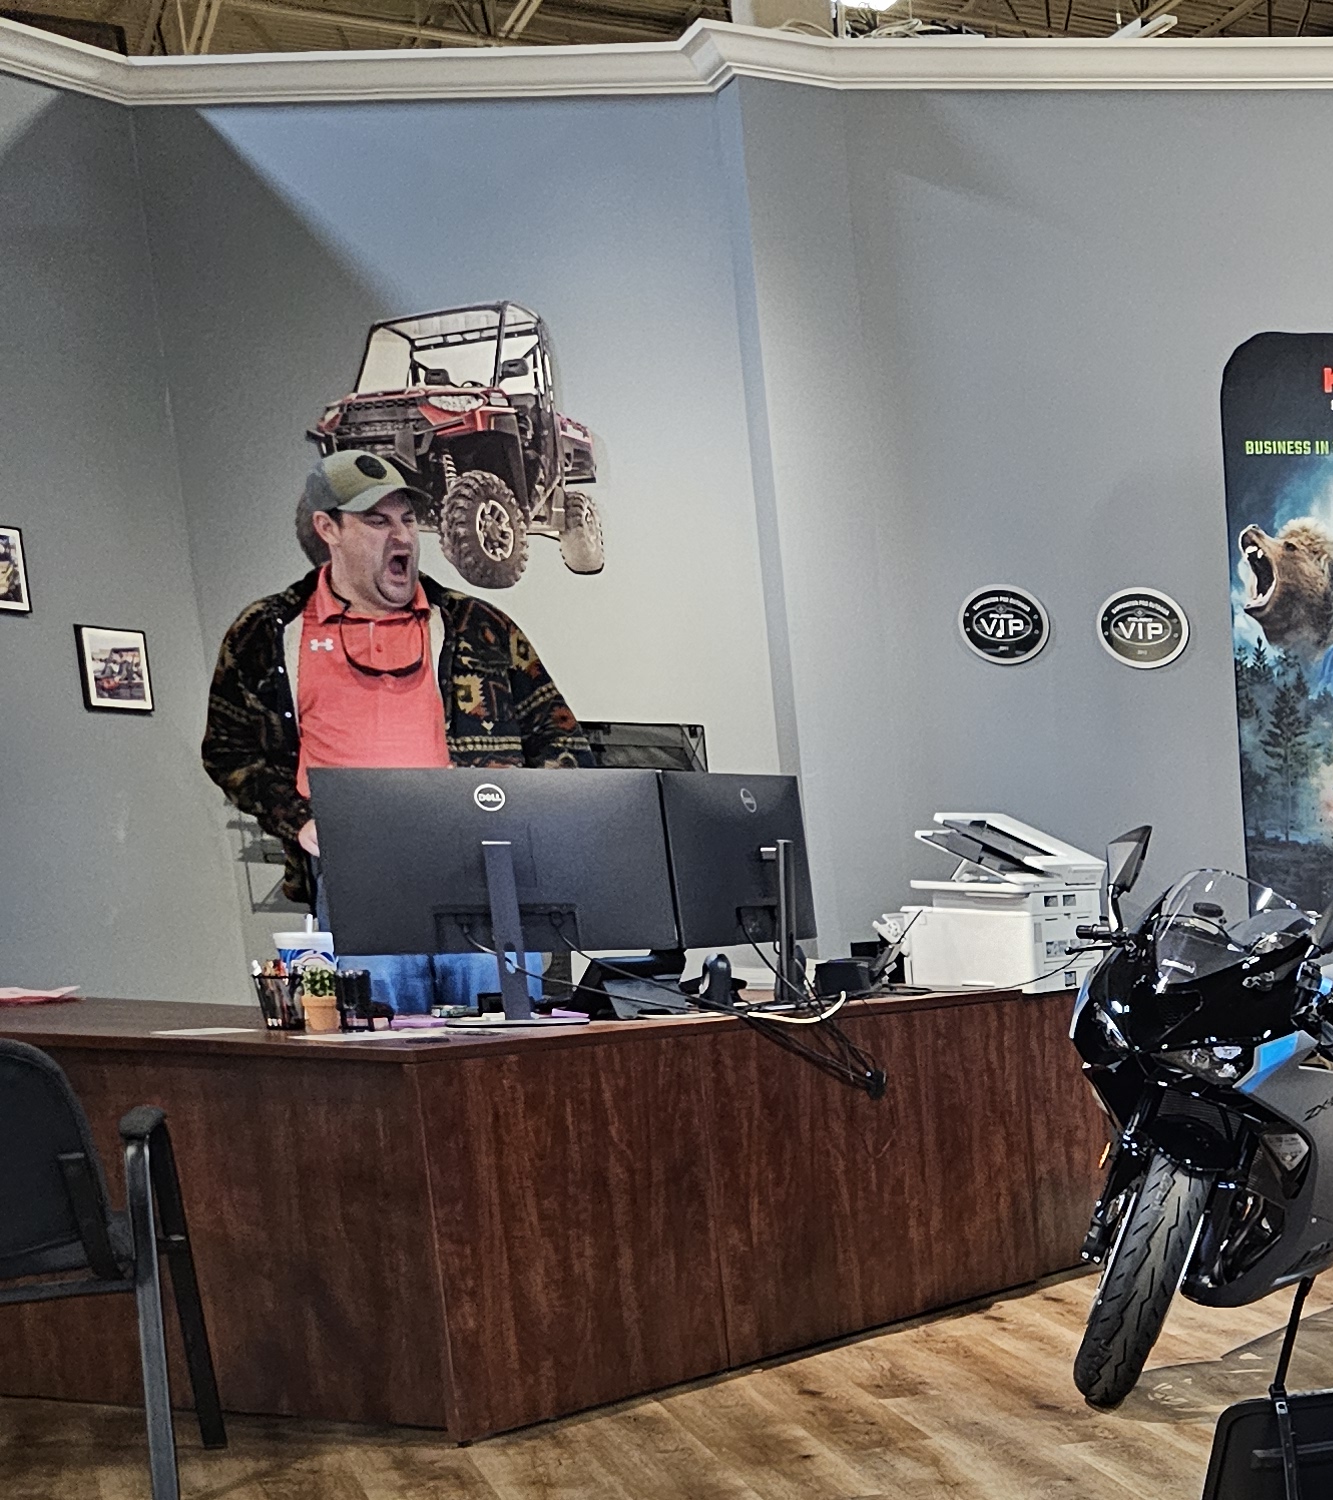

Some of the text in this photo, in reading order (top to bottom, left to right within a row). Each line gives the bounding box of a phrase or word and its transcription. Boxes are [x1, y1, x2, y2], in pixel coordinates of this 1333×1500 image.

[1245, 440, 1311, 455] BUSINESS
[1315, 440, 1329, 455] IN
[979, 617, 1024, 637] VIP
[1117, 621, 1163, 640] VIP
[478, 793, 502, 802] DELL
